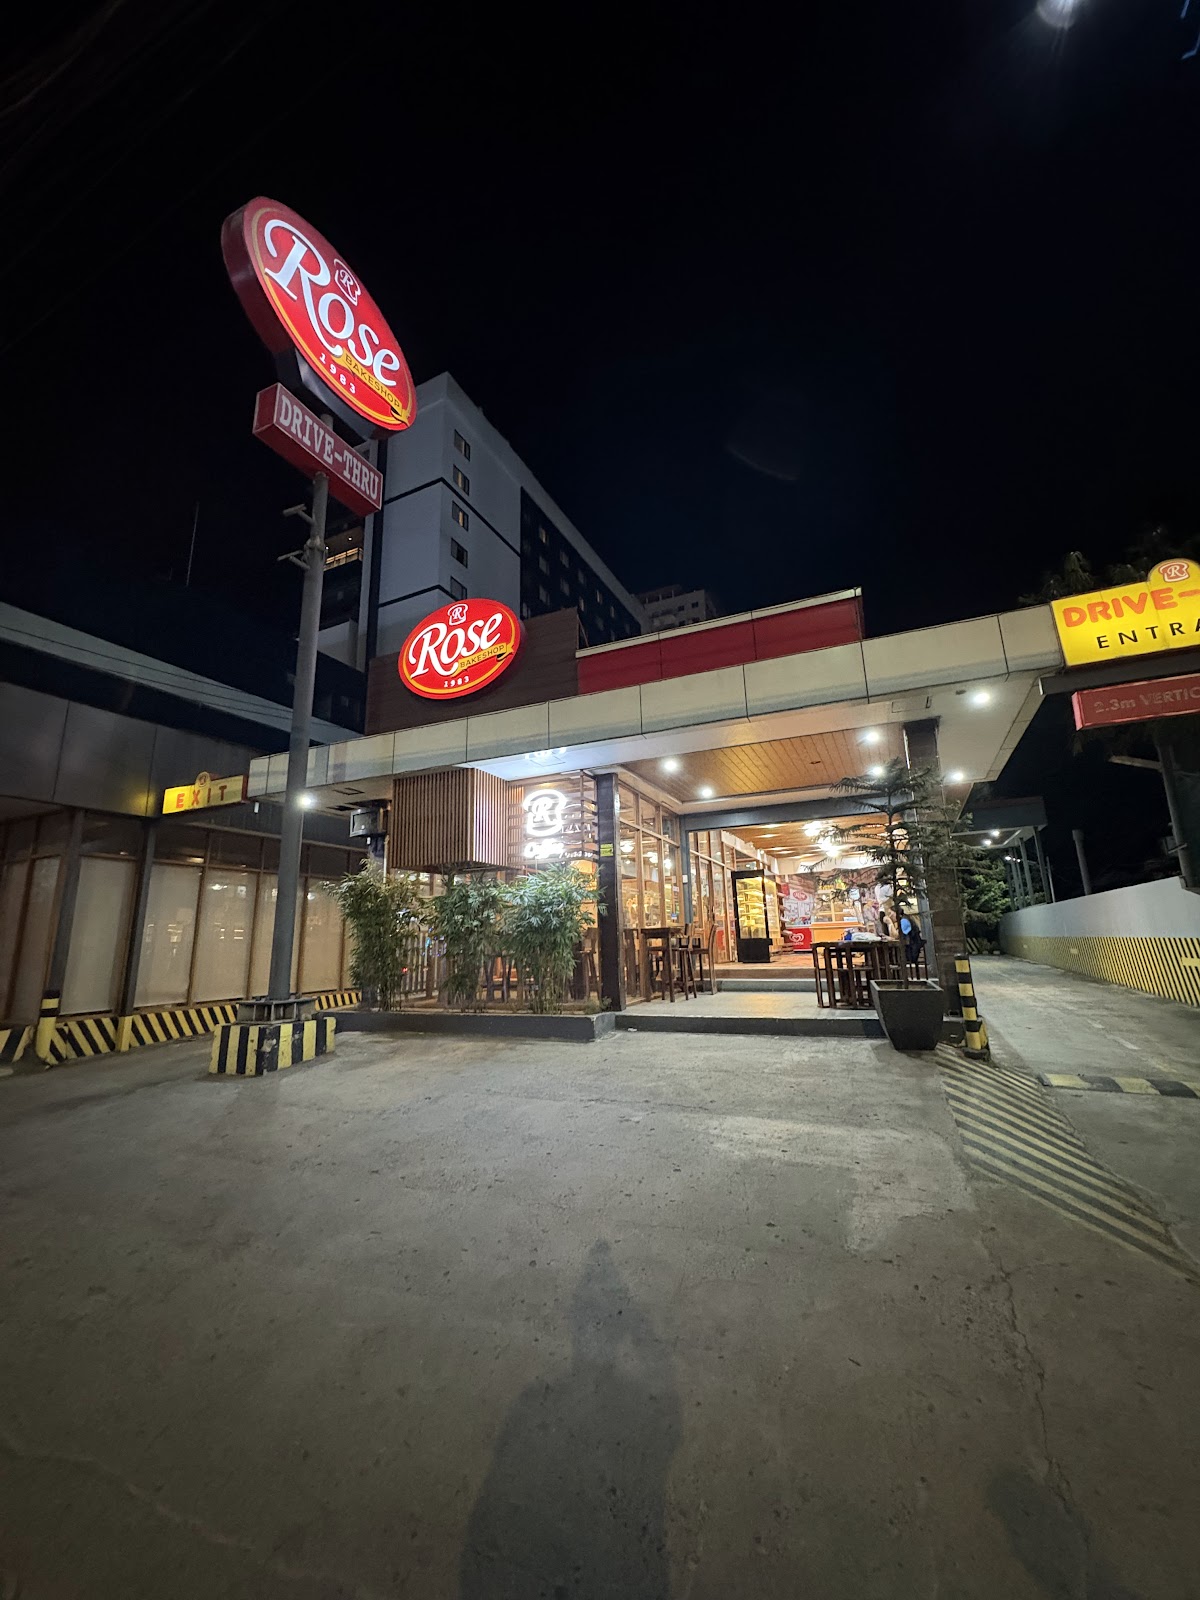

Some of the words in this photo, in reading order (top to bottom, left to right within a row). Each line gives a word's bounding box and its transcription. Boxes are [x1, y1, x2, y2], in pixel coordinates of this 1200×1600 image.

[264, 218, 400, 386] Rose
[319, 352, 357, 395] 1983
[345, 354, 401, 409] BAKESHOP
[278, 394, 380, 501] DRIVE-THRU
[408, 612, 503, 679] Rose
[459, 644, 505, 669] BAKESHOP
[443, 676, 470, 688] 1983
[1093, 698, 1137, 714] 2.3m
[175, 784, 228, 809] EXIT
